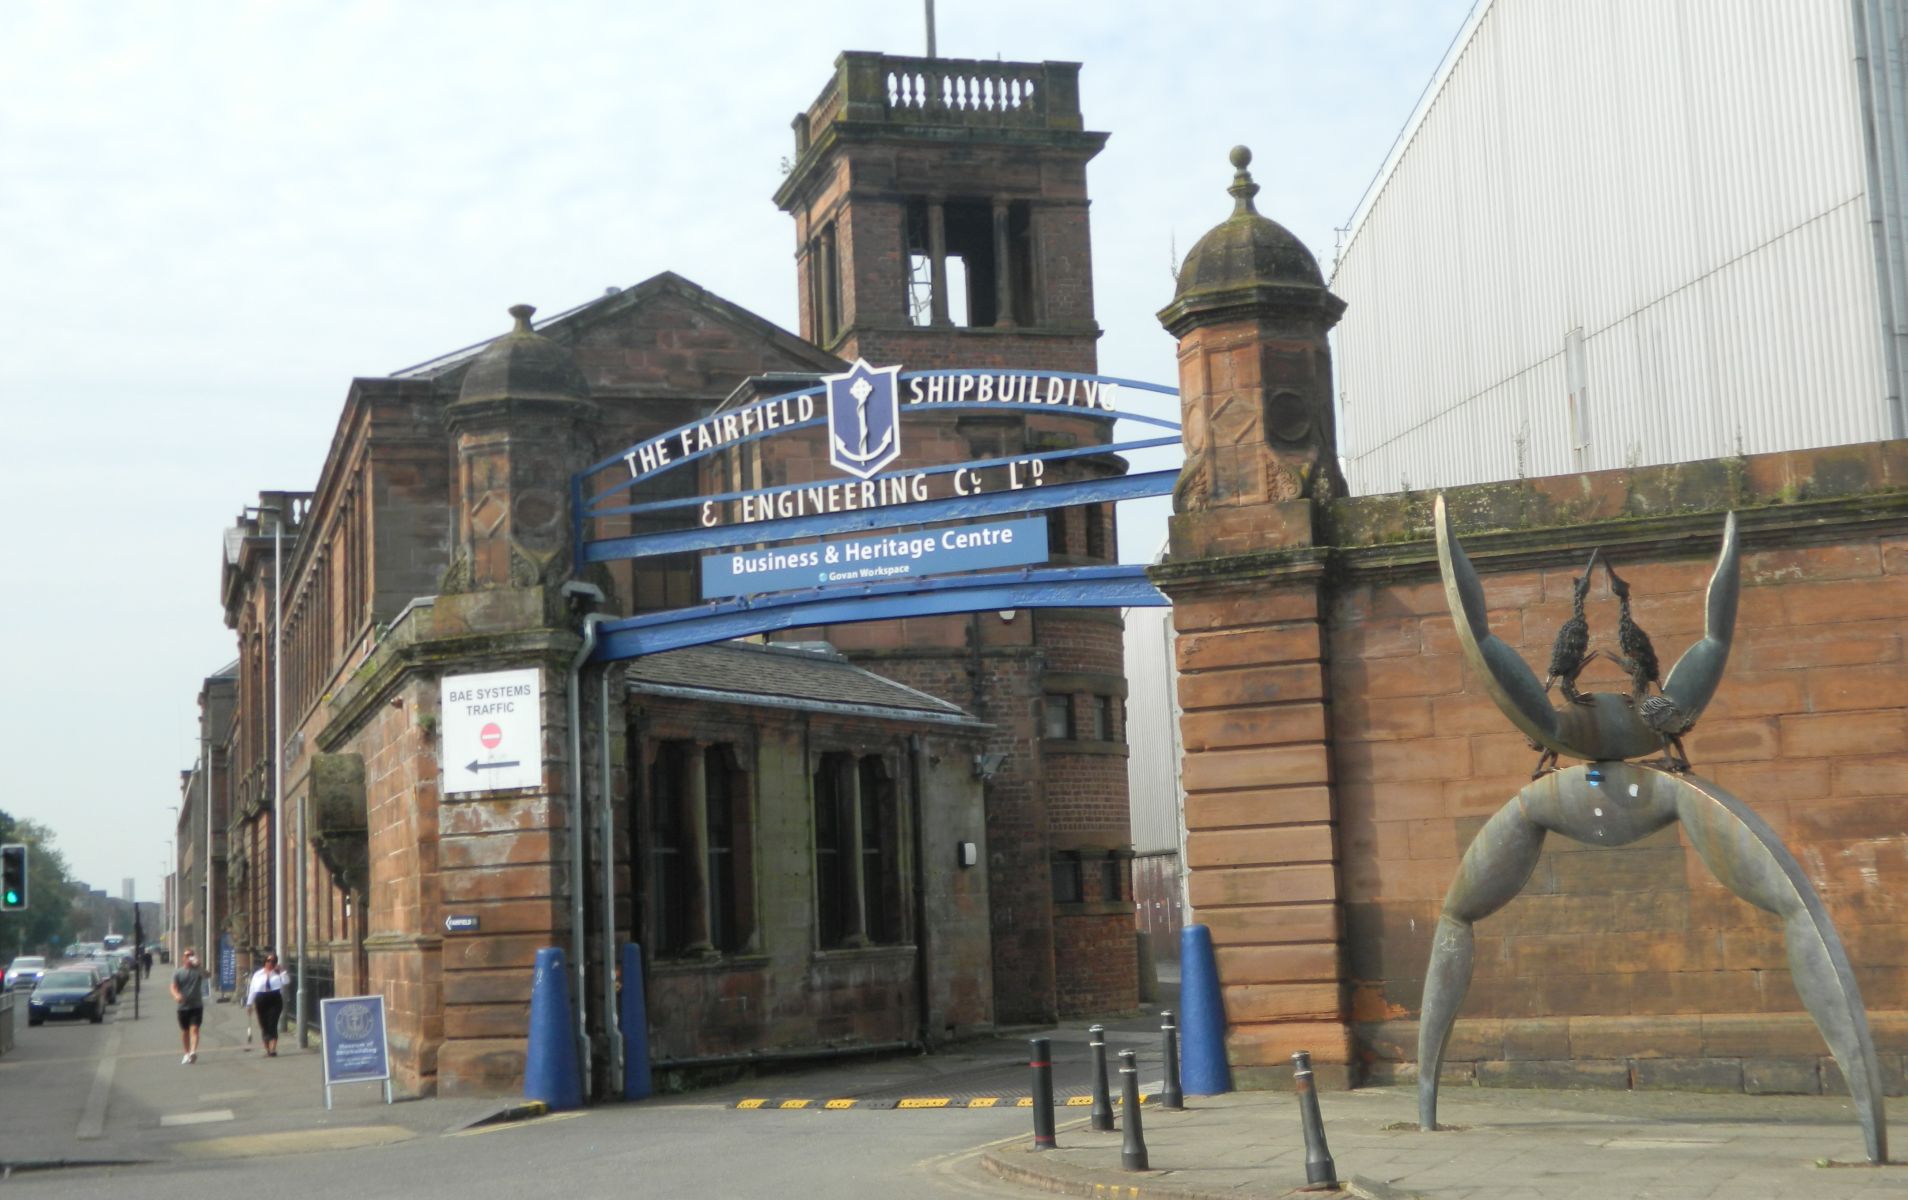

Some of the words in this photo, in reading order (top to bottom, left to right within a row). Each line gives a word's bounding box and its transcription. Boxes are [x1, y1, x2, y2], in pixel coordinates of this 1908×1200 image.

[624, 438, 671, 478] THE
[681, 394, 814, 456] FAIRFIELD
[910, 374, 1119, 411] SHIPBUILDING
[702, 500, 717, 527] &
[743, 473, 928, 523] ENGINEERING
[732, 547, 819, 575] Business
[824, 545, 839, 565] &
[846, 536, 935, 562] Heritage
[941, 526, 1013, 549] Centre
[828, 569, 858, 582] Govan
[860, 563, 910, 579] Workspace
[449, 690, 473, 702] BAE
[476, 684, 531, 700] SYSTEMS
[466, 702, 515, 716] TRAFFIC
